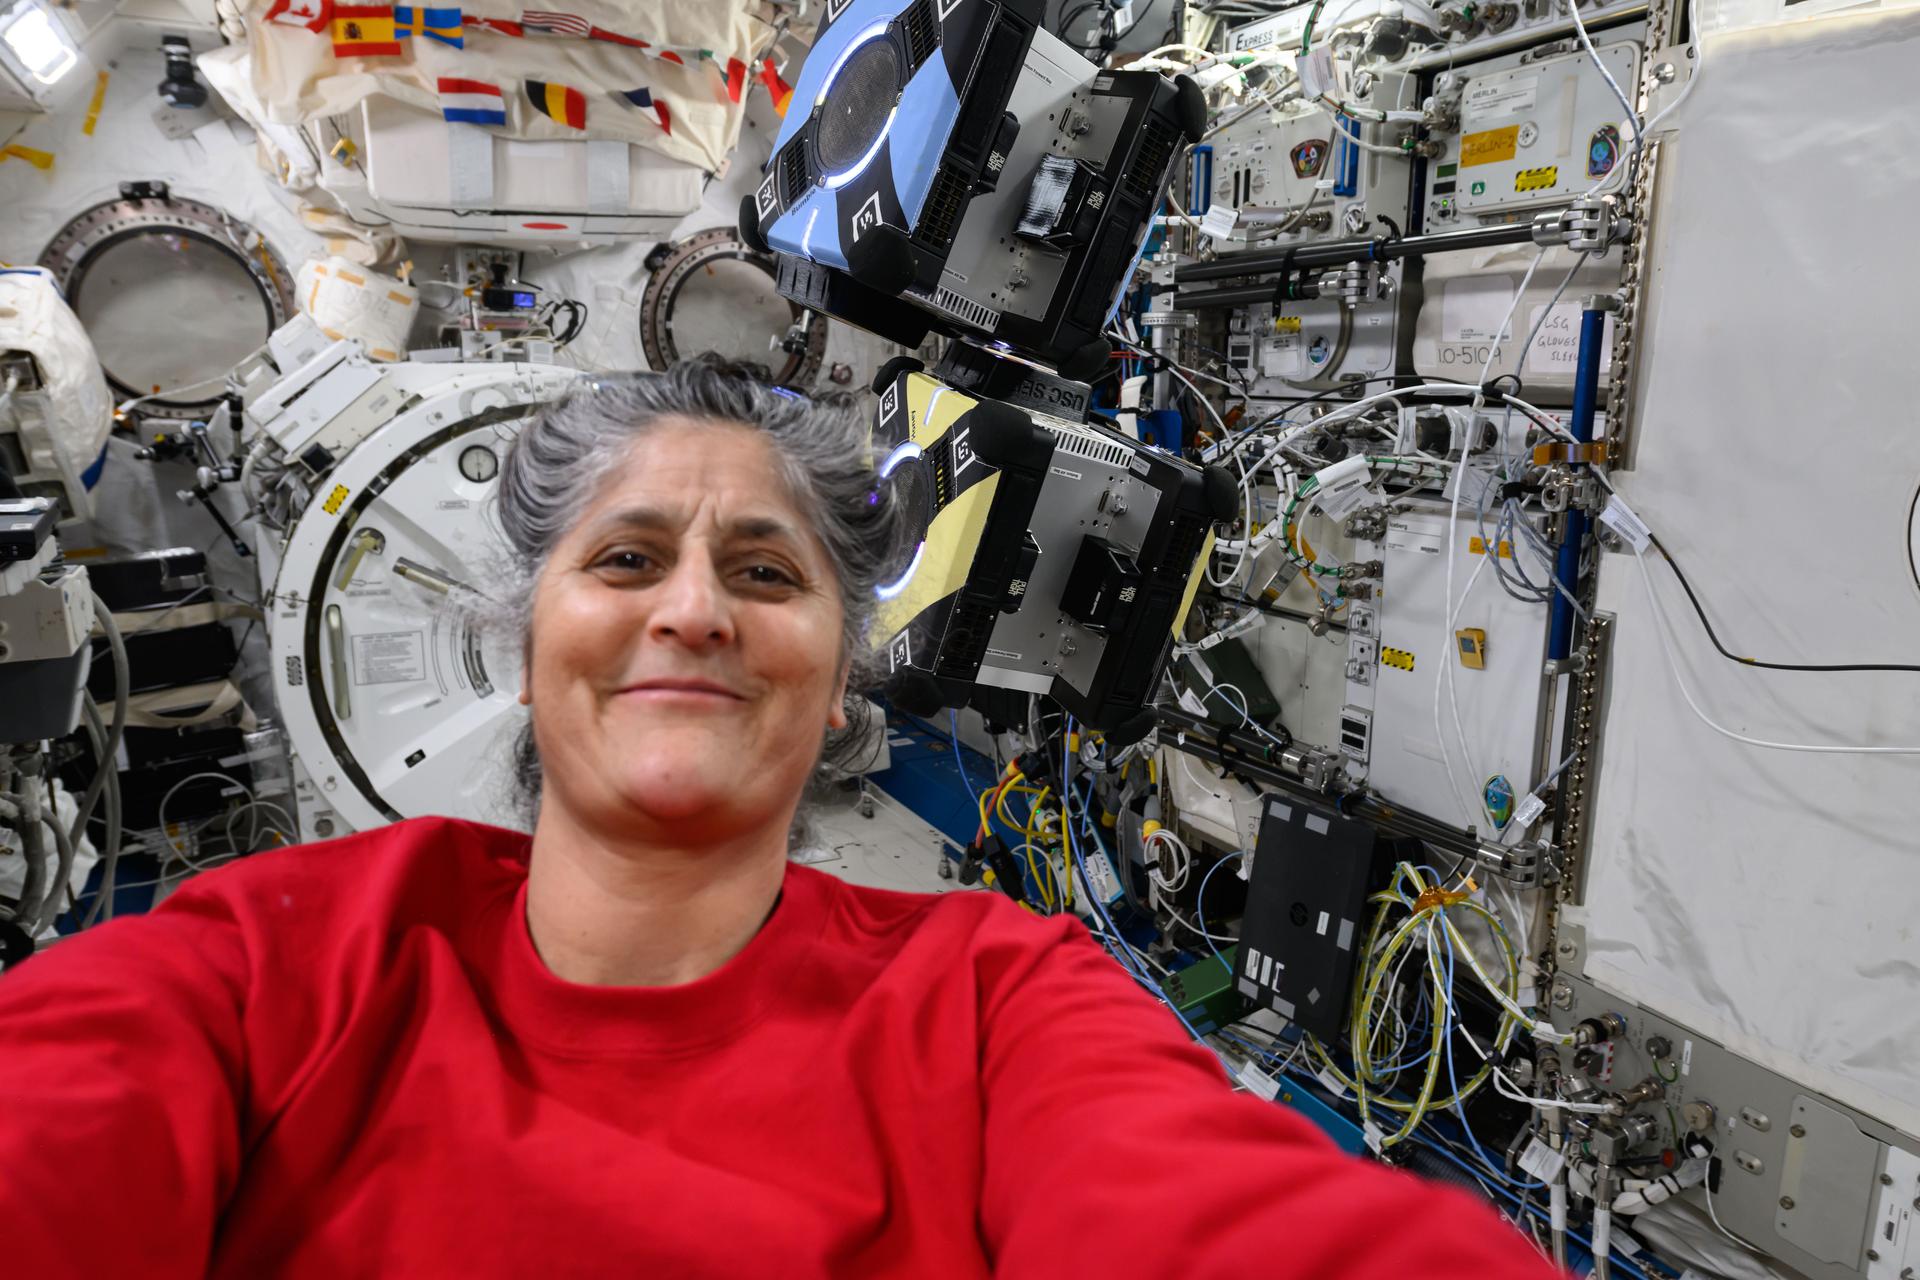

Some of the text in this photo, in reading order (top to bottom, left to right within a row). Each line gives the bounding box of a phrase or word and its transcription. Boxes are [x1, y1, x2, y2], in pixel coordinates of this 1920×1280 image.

[1472, 88, 1498, 99] MERLIN
[1537, 335, 1577, 348] GLOVES
[1049, 387, 1085, 412] USC
